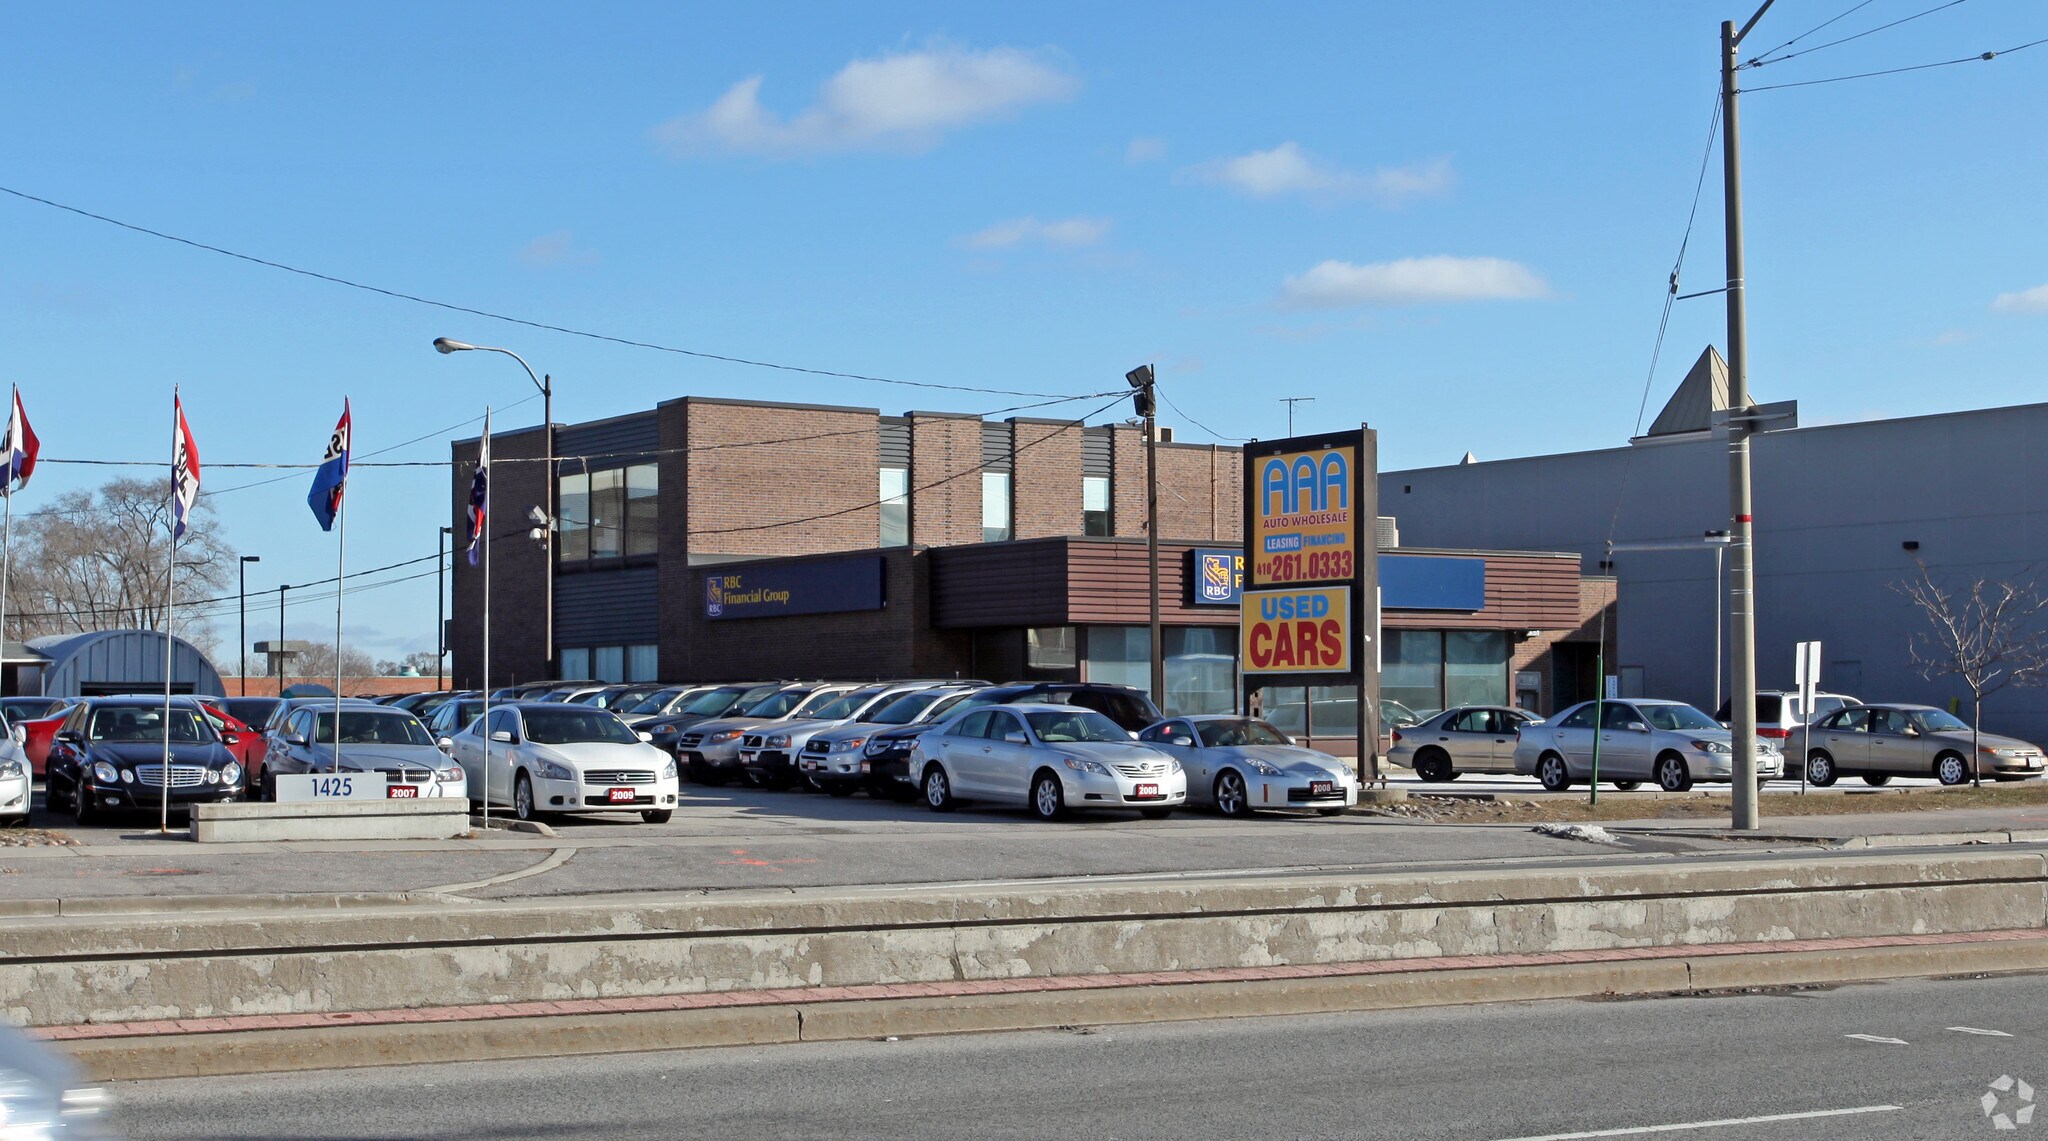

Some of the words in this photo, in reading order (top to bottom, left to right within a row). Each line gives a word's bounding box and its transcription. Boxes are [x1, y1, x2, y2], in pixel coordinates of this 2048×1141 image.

[1262, 451, 1348, 517] AAA
[1263, 517, 1289, 529] AUTO
[1292, 512, 1347, 527] WHOLESALE
[1267, 536, 1299, 550] LEASING
[1271, 550, 1352, 582] 261.0333
[724, 576, 741, 588] RBC
[724, 588, 760, 605] Financial
[763, 589, 789, 605] Group
[1206, 585, 1228, 596] RBC
[709, 604, 721, 613] RBC
[1261, 594, 1329, 621] USED
[1250, 619, 1342, 668] CARS
[311, 777, 353, 797] 1425
[391, 788, 416, 798] 2007
[1138, 786, 1158, 795] 2008
[1313, 783, 1331, 793] 2008
[611, 791, 635, 801] 2009
